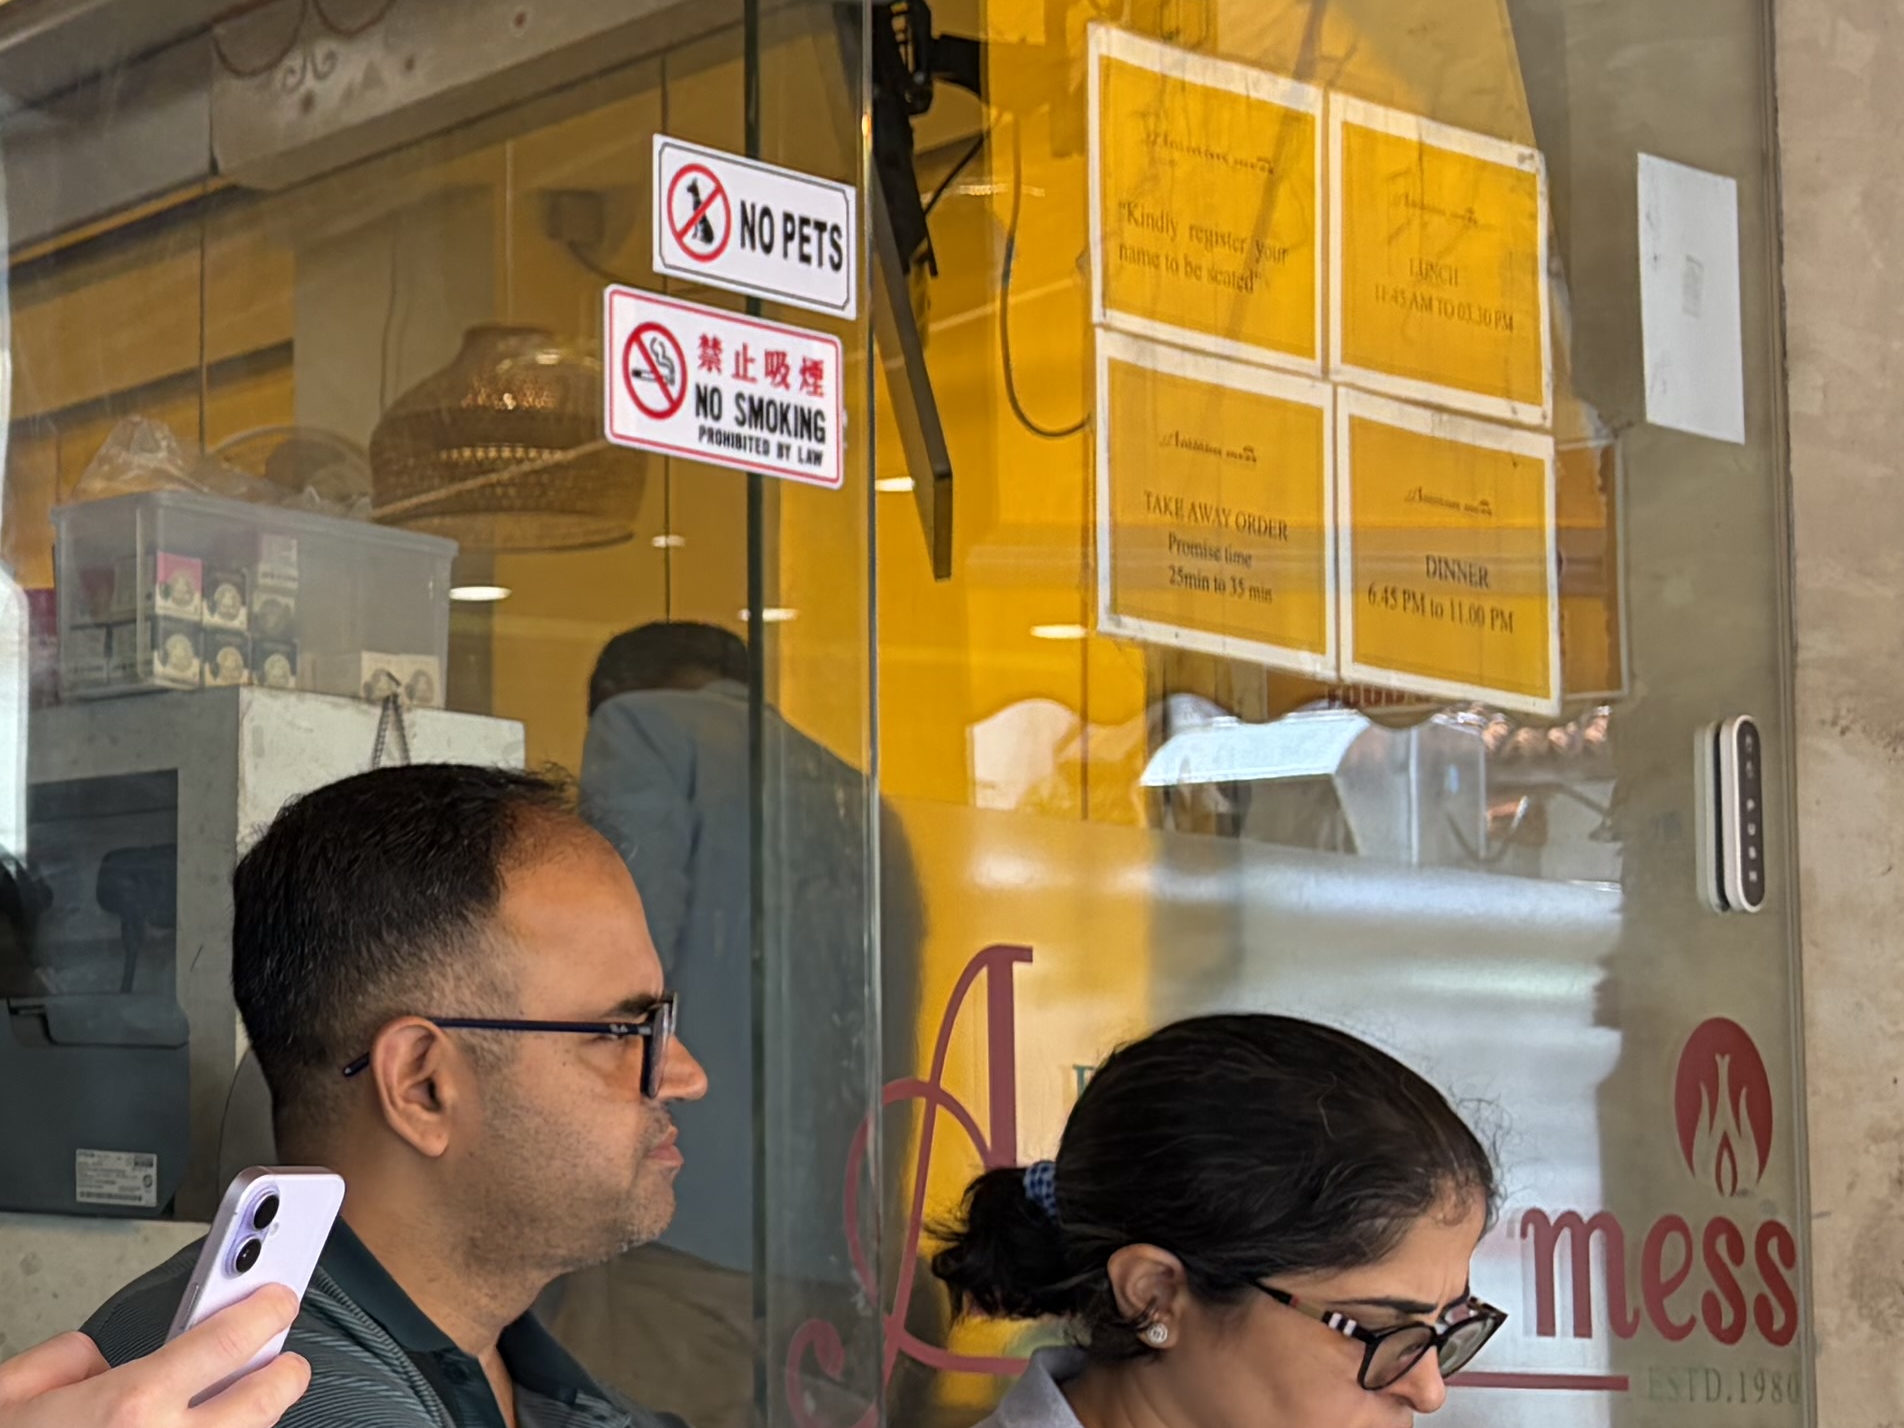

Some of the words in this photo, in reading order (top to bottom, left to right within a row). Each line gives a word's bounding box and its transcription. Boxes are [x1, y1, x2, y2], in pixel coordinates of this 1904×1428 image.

[740, 199, 774, 256] NO
[782, 210, 843, 272] PETS
[1189, 224, 1247, 254] register
[1255, 239, 1290, 264] your
[1119, 243, 1160, 269] name
[1165, 252, 1179, 273] to
[1184, 254, 1202, 281] be
[1409, 257, 1458, 287] LUNCH
[1410, 292, 1433, 313] AM
[1436, 298, 1455, 318] TO
[1494, 310, 1513, 332] PM
[698, 333, 824, 398] 禁止吸煙
[695, 383, 722, 422] NO
[734, 391, 826, 444] SMOKING
[699, 425, 770, 457] PROHIBITED
[777, 441, 791, 460] BY
[798, 446, 824, 467] LAW
[1144, 490, 1184, 521] TAKE
[1188, 501, 1232, 530] AWAY
[1234, 510, 1289, 541] ORDER
[1168, 531, 1221, 563] Promise
[1224, 545, 1252, 569] time
[1168, 564, 1210, 592] 25min
[1214, 576, 1226, 595] to
[1229, 575, 1245, 599] 35
[1249, 584, 1273, 604] min
[1425, 554, 1489, 589] DINNER
[1368, 581, 1398, 610] 6.45
[1402, 588, 1425, 616] PM
[1430, 598, 1444, 619] to
[1450, 598, 1485, 628] 11.00
[1490, 607, 1513, 634] PM
[1520, 1207, 1798, 1346] mess
